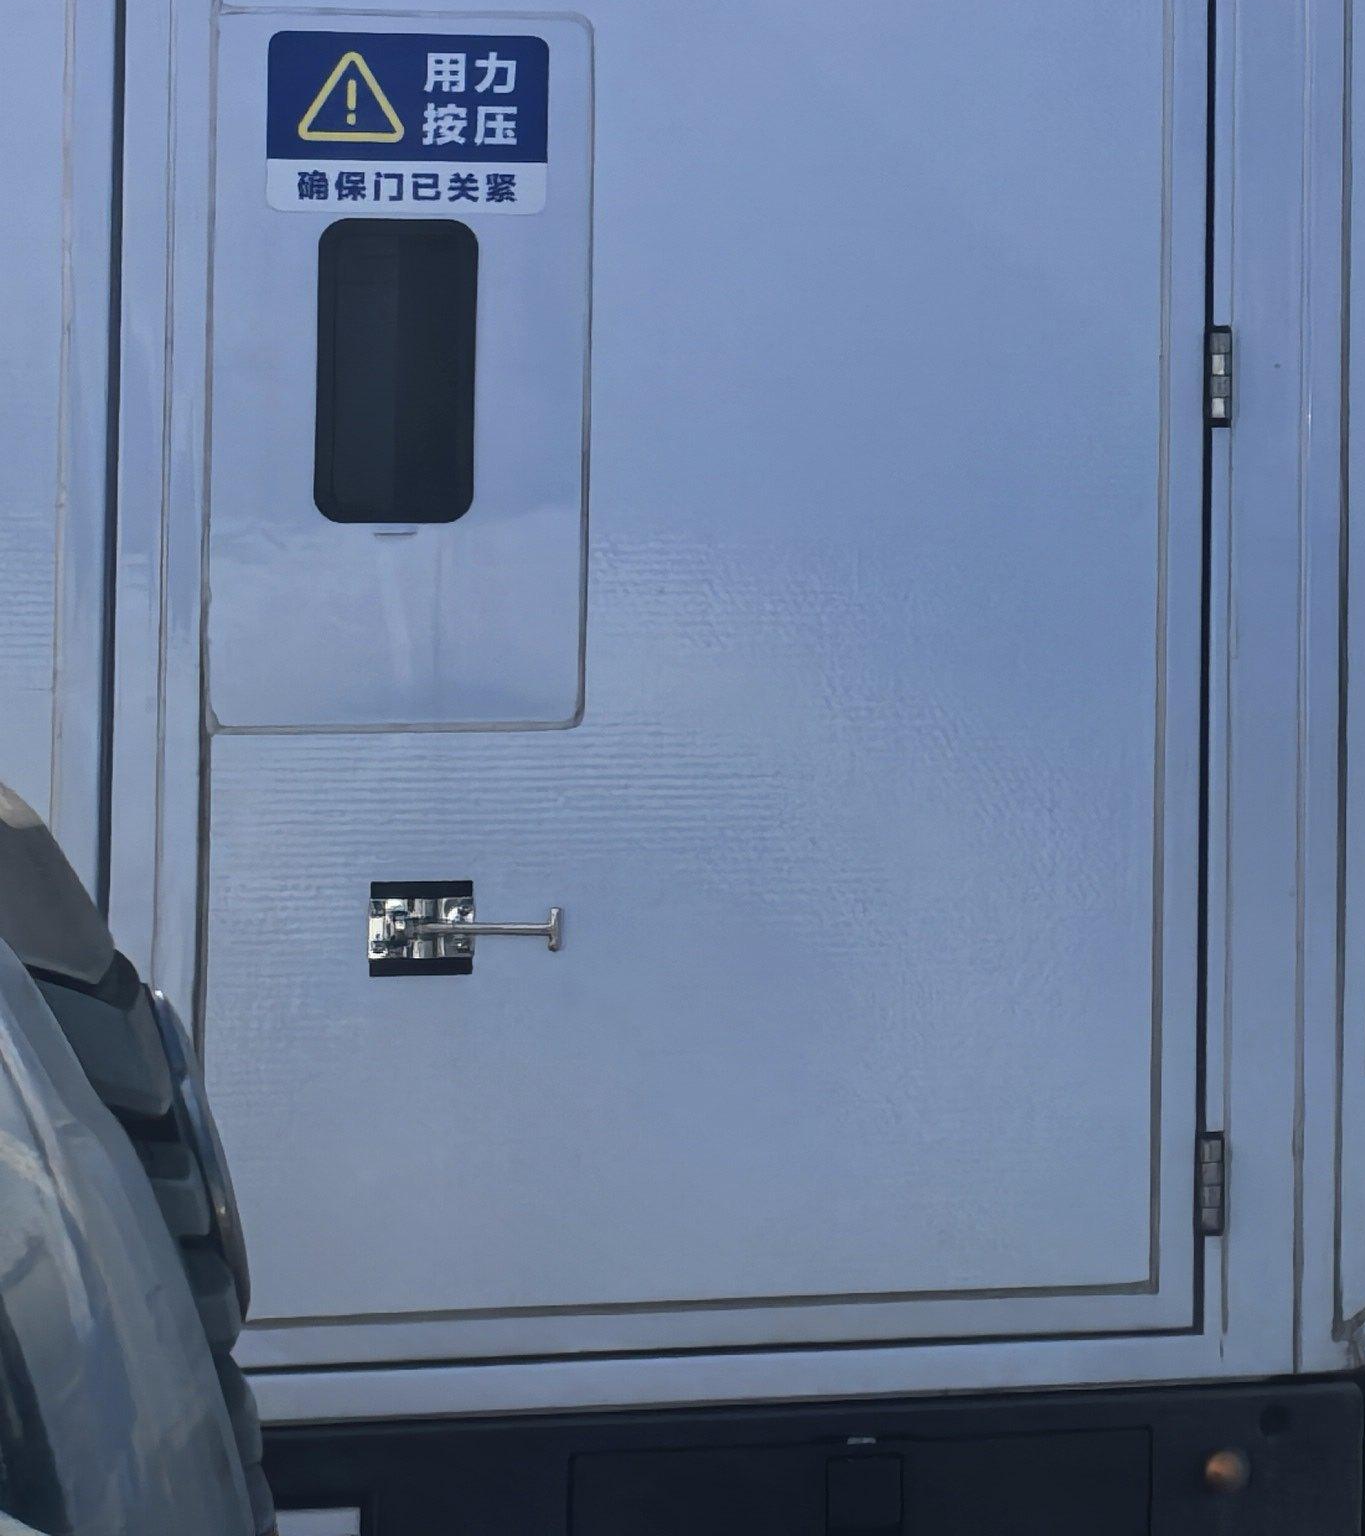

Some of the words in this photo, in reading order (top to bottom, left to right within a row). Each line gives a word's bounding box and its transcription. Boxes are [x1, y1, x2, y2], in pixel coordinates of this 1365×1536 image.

[423, 51, 518, 94] 用力
[421, 102, 518, 146] 按压
[296, 169, 518, 203] 确保门已关紧
